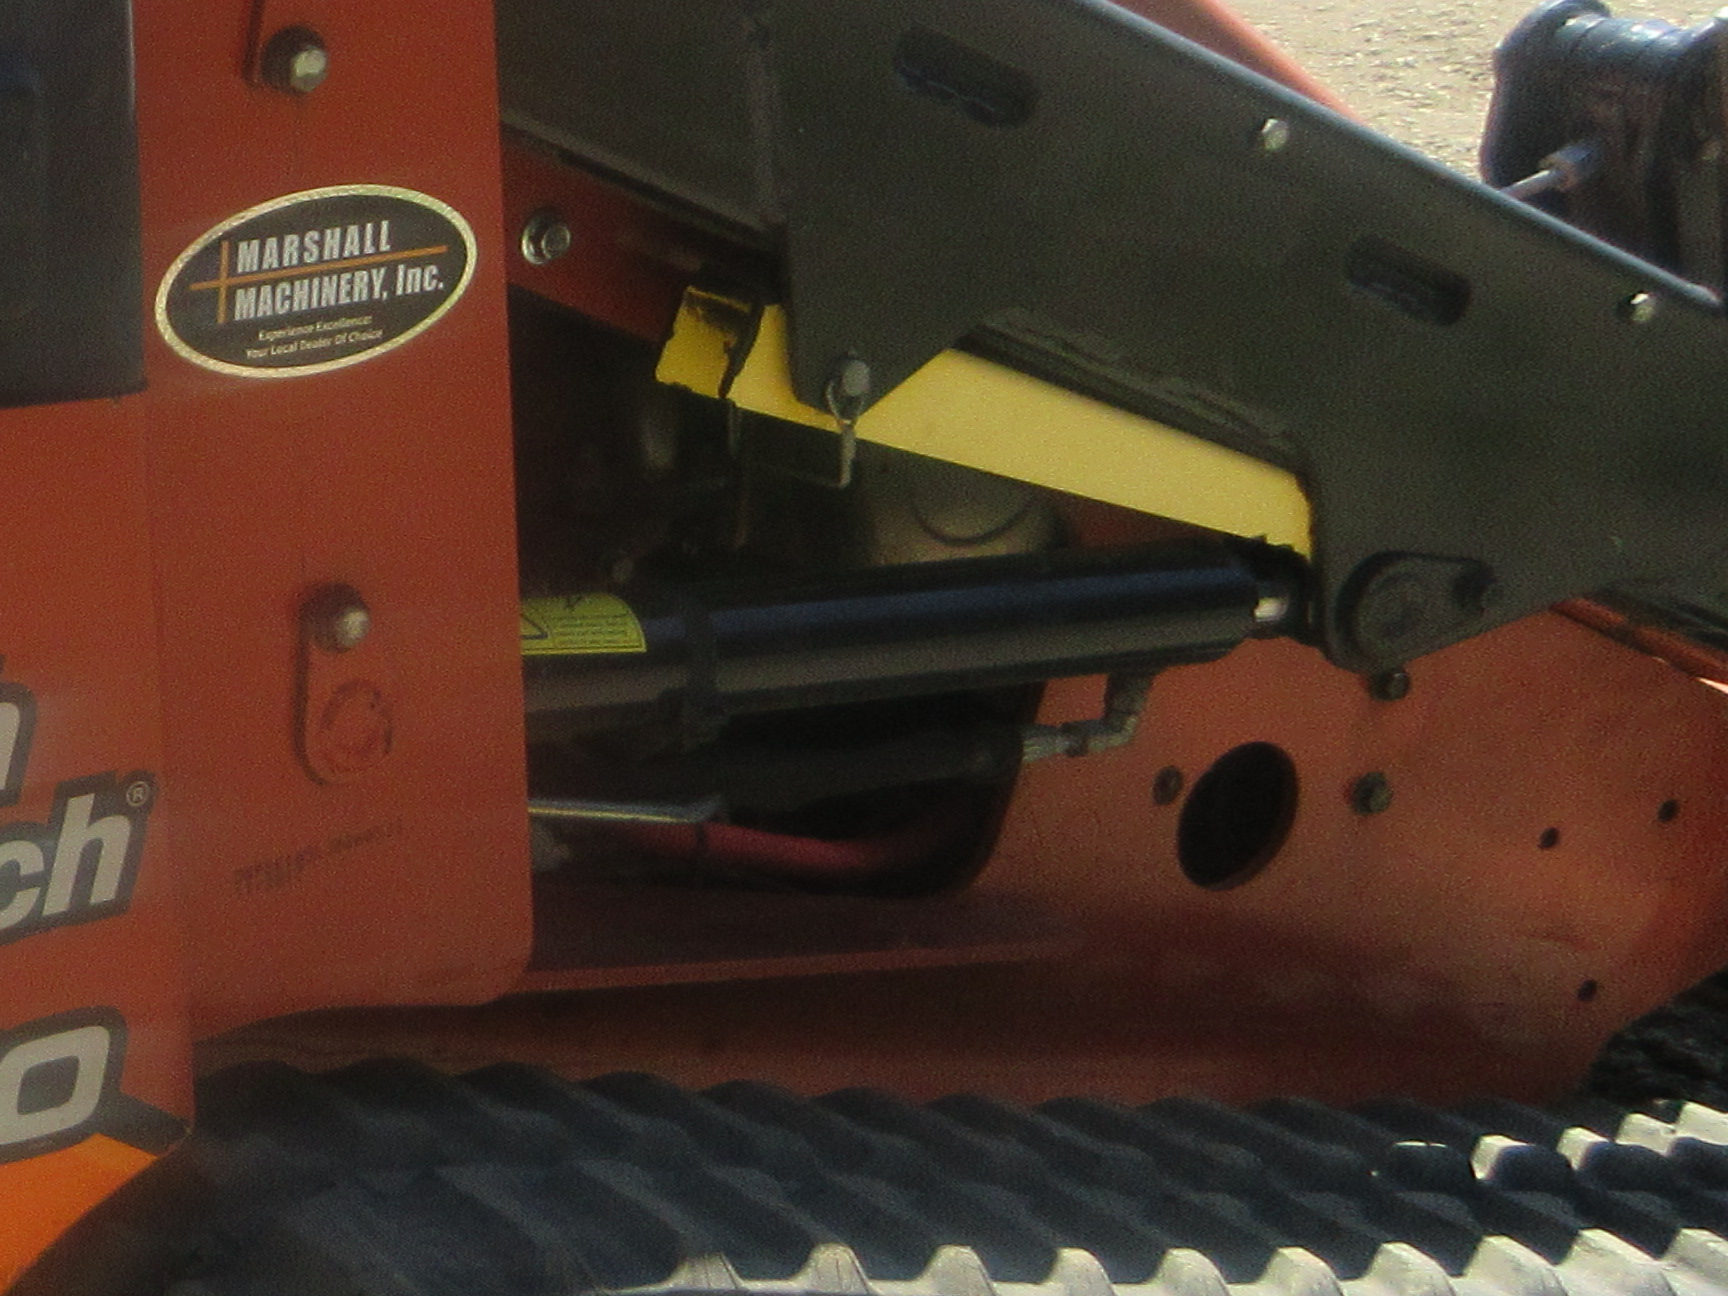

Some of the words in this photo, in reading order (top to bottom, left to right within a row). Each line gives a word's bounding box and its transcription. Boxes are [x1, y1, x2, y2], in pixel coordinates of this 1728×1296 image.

[236, 219, 392, 275] MARSHALL
[234, 266, 388, 322] MACHINERY,
[395, 263, 444, 296] Inc.
[270, 342, 298, 356] Local
[299, 337, 332, 351] Dealer
